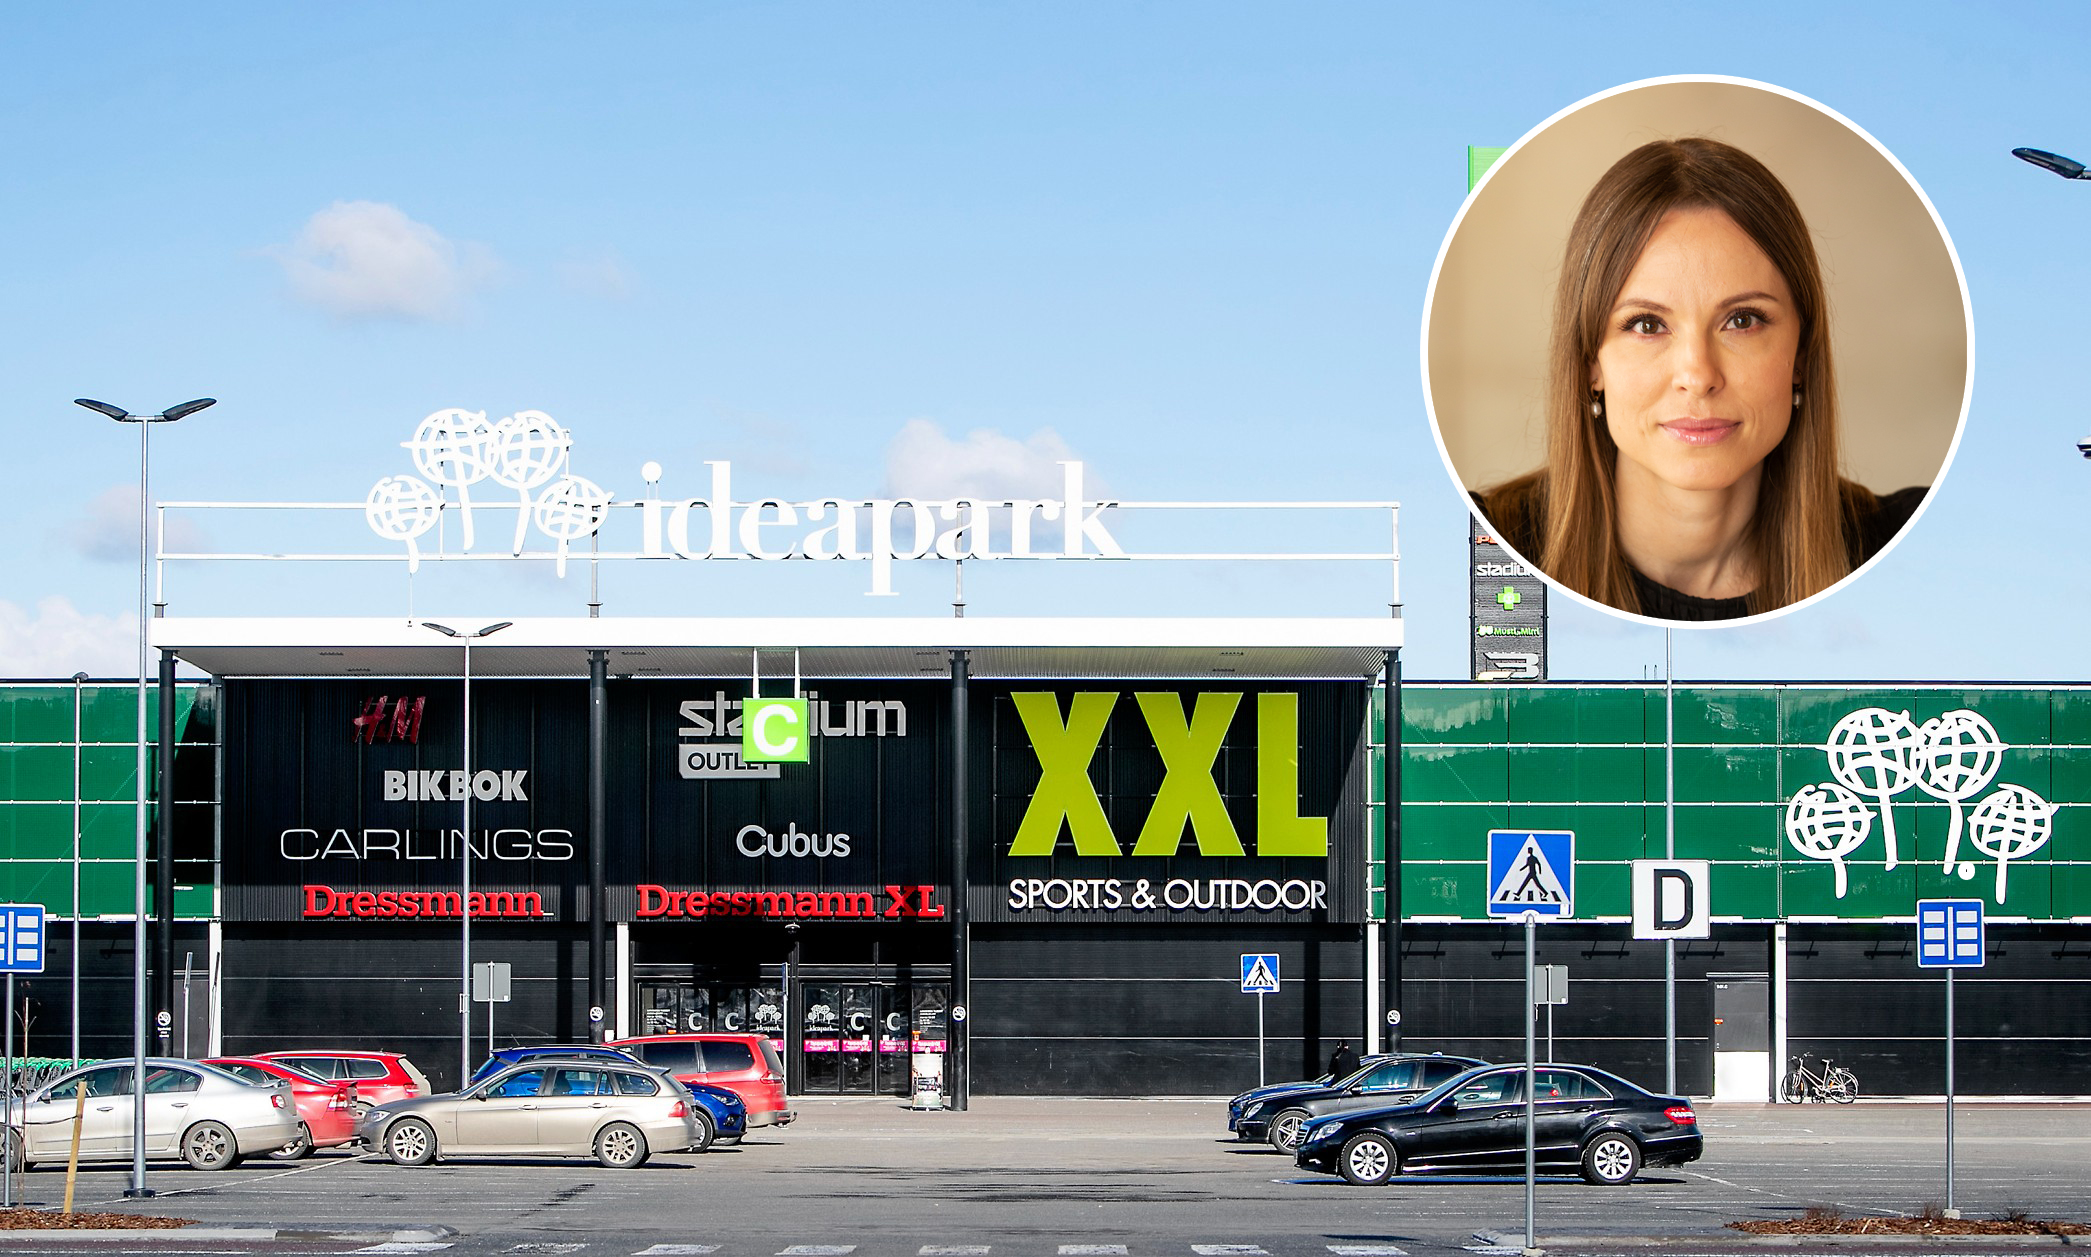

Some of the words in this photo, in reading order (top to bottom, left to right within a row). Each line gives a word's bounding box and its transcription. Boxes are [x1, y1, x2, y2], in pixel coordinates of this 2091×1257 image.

[641, 460, 1129, 596] ideapark
[352, 695, 426, 745] H&M
[679, 690, 907, 737] stium
[752, 703, 799, 757] C
[687, 752, 769, 771] OUTL
[1008, 691, 1329, 857] XXL
[280, 828, 575, 861] CARLINGS
[736, 821, 851, 858] Cubus
[303, 885, 546, 918] Dressmann
[636, 884, 877, 918] Dressmann
[885, 885, 945, 918] XL
[1009, 878, 1123, 910] SPORTS
[1131, 878, 1157, 910] &
[1163, 878, 1328, 910] OUTDOOR
[1653, 868, 1694, 932] D
[688, 1012, 703, 1031] C
[724, 1012, 739, 1031] C
[850, 1012, 865, 1031] C
[886, 1012, 901, 1031] C
